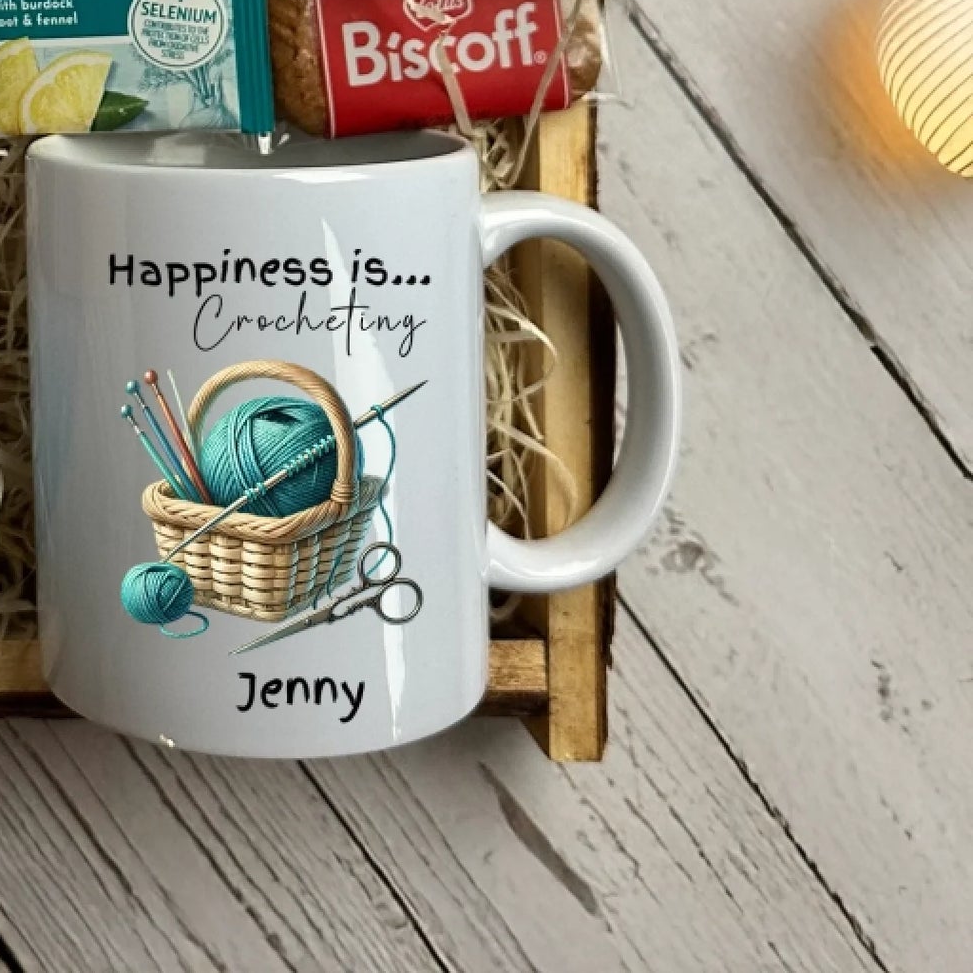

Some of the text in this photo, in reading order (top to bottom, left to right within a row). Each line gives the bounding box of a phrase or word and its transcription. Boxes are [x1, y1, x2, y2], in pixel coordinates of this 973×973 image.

[22, 14, 33, 27] &
[36, 10, 79, 25] fennel
[141, 1, 217, 25] SELENIUM
[341, 3, 537, 87] Biscoff
[108, 249, 431, 297] Happiness is...
[193, 288, 427, 357] Crocheting
[236, 671, 366, 723] Jenny
